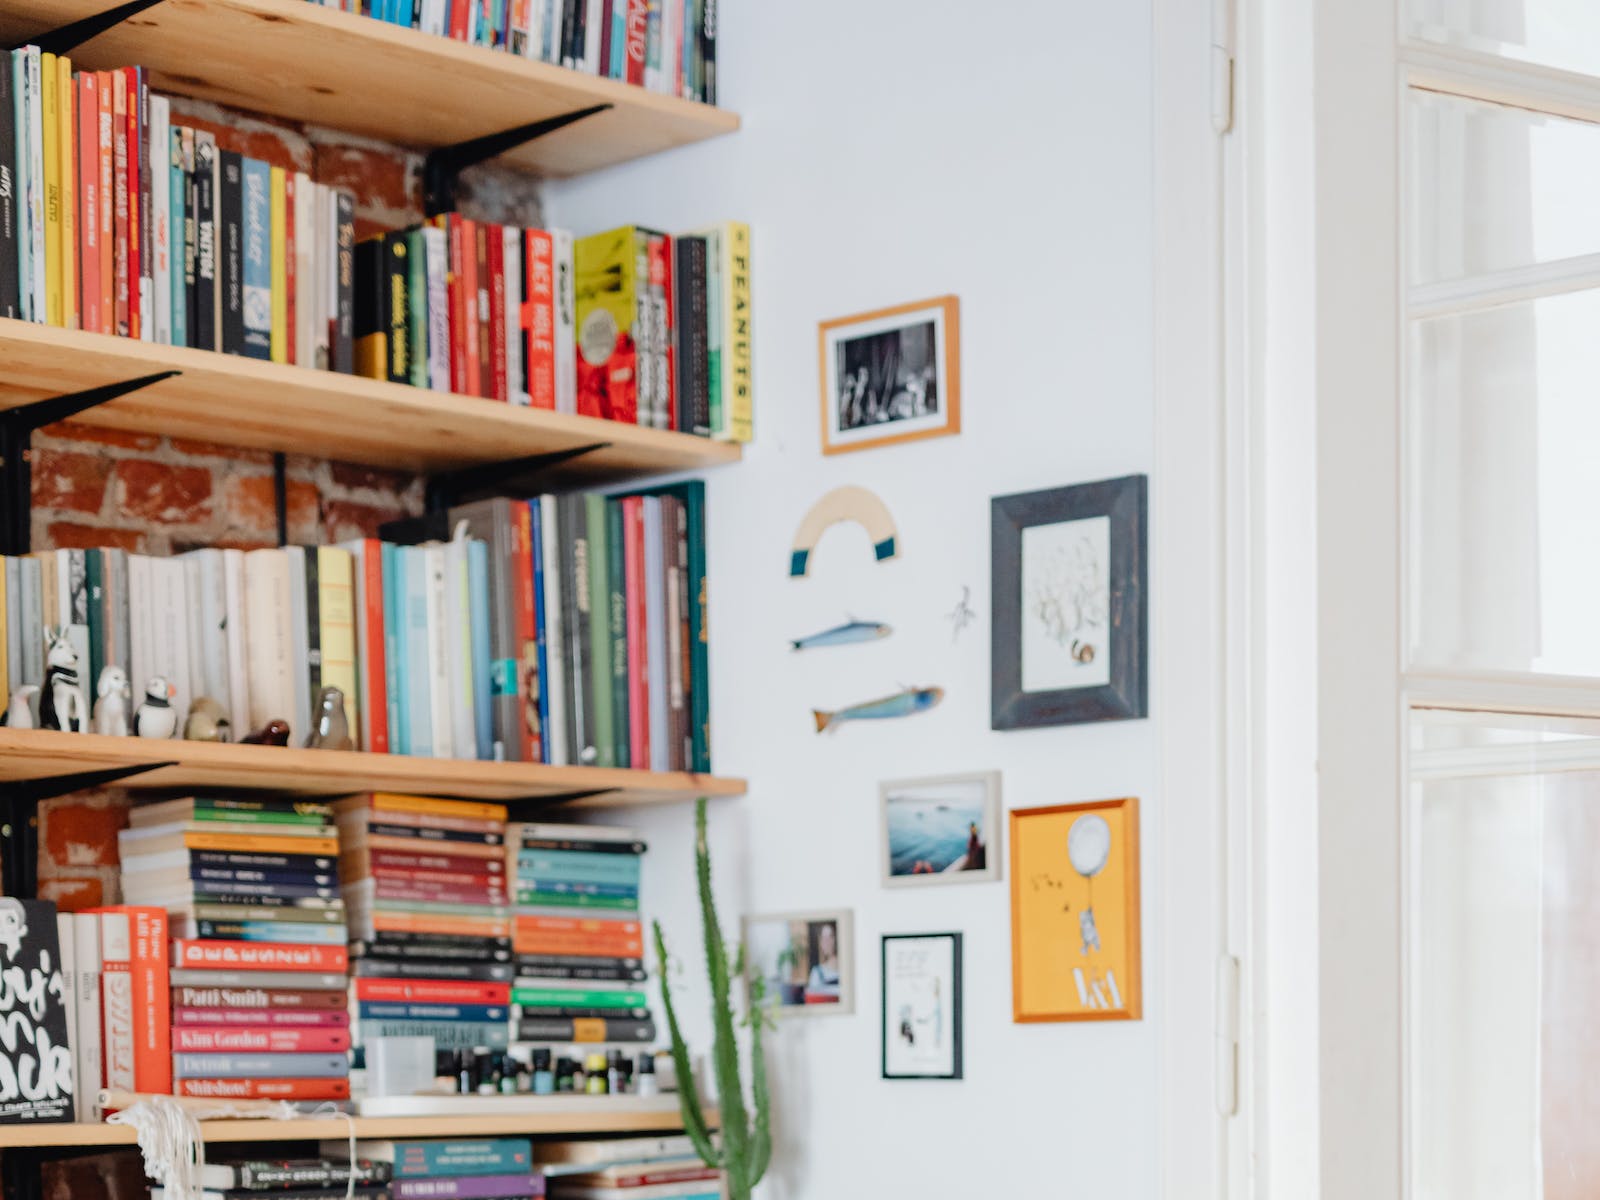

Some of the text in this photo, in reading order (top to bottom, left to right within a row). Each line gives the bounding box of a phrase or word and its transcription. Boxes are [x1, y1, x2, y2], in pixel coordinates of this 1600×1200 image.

[531, 238, 552, 353] BLACK HOLE
[732, 254, 750, 398] PEANUTS
[182, 987, 220, 1007] Patti
[221, 988, 270, 1007] Smith
[181, 1030, 213, 1048] Kim
[214, 1030, 268, 1048] Gordon
